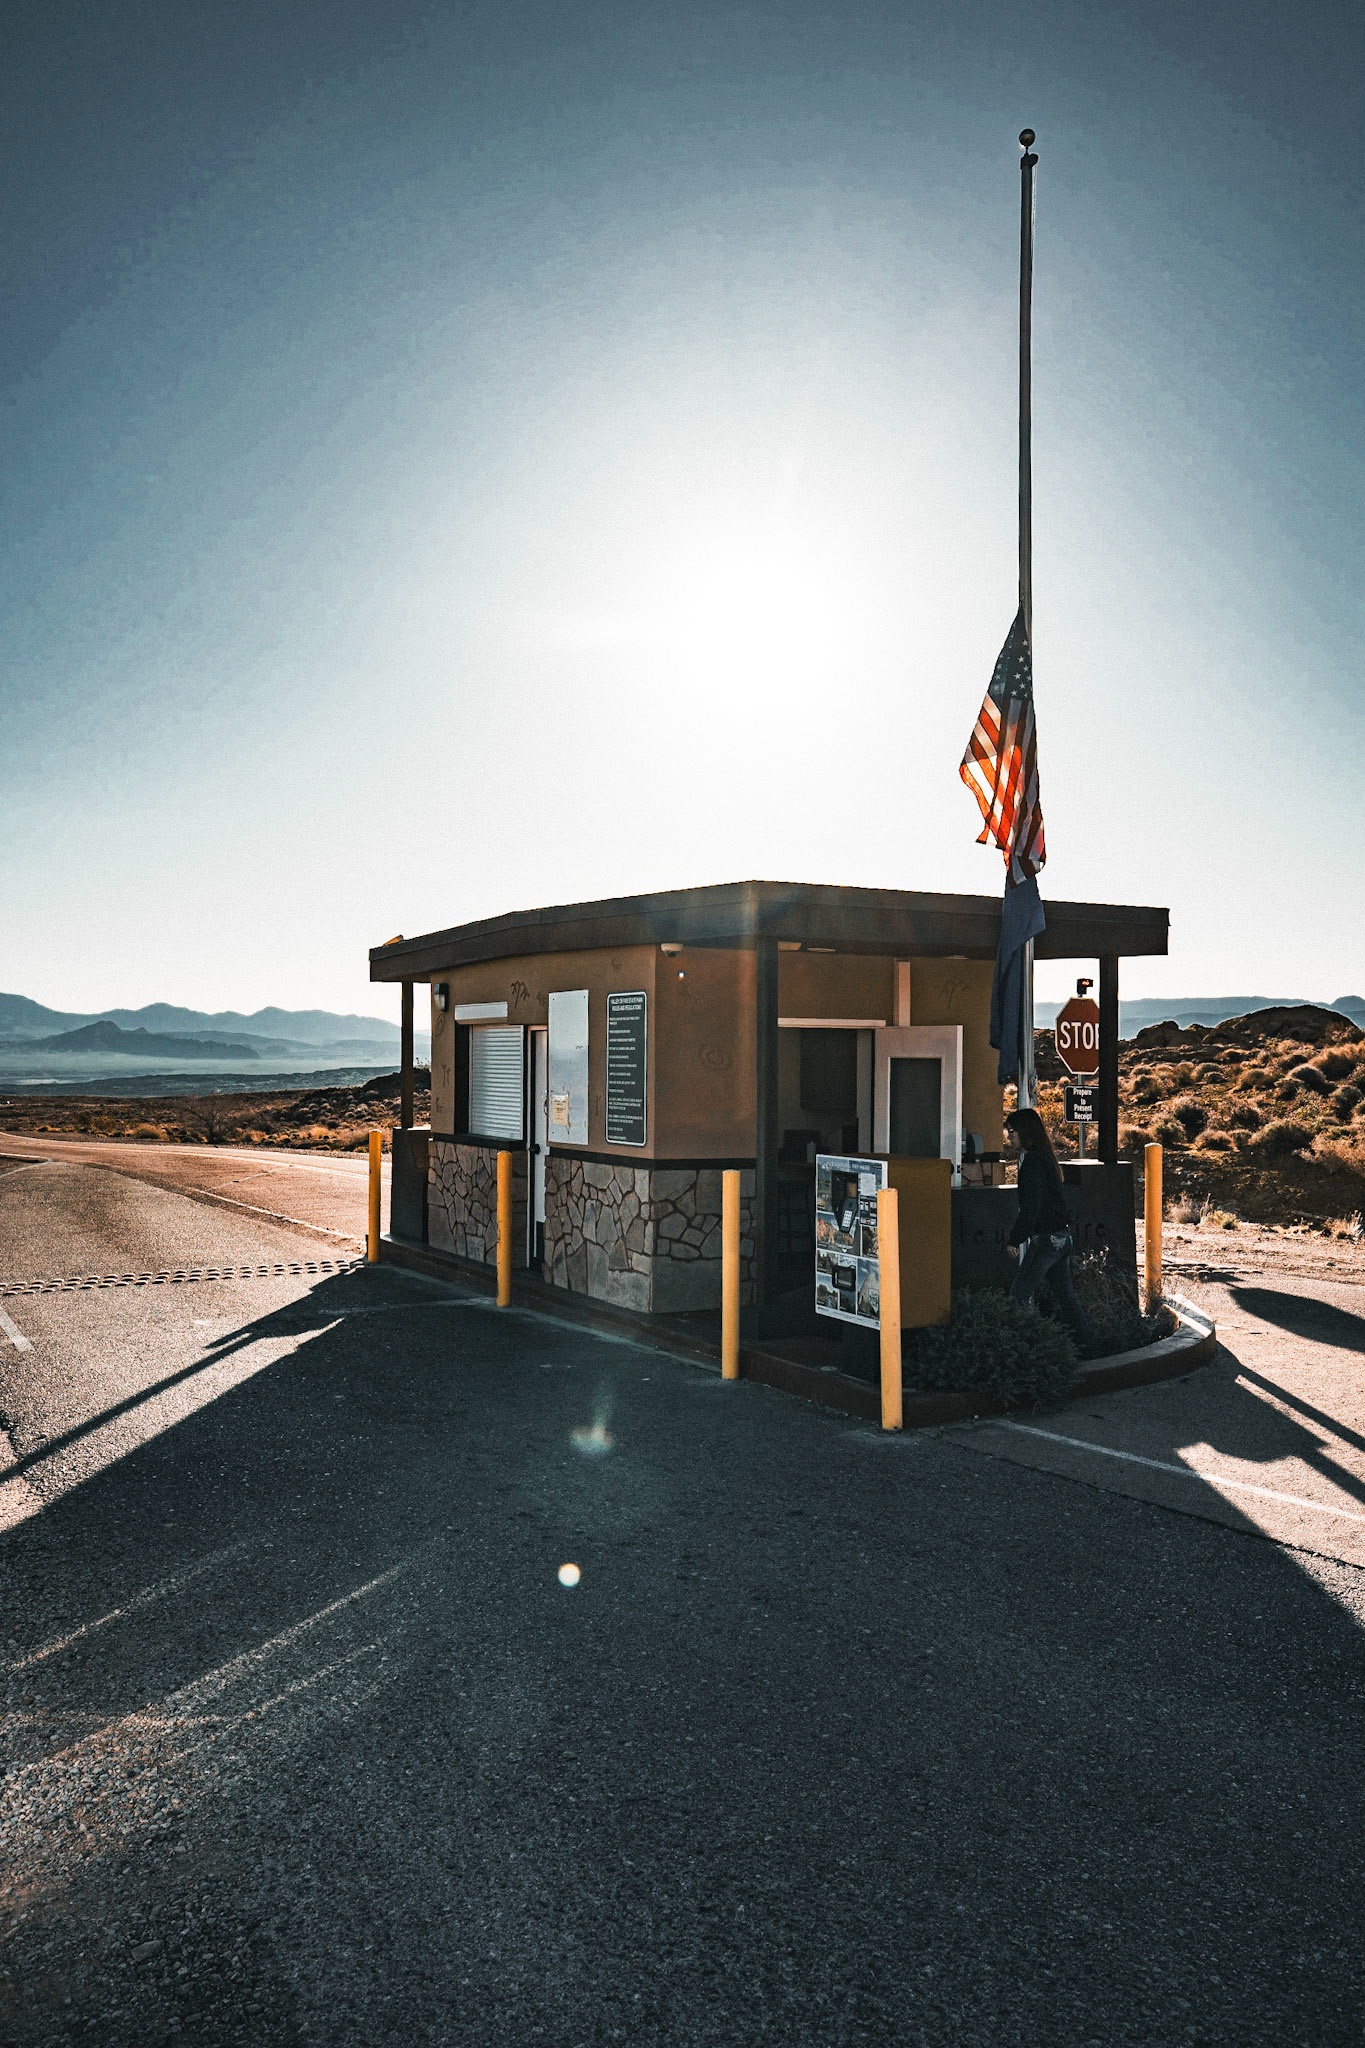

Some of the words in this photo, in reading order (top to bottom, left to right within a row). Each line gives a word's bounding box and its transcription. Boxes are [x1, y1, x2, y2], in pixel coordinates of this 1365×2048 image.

[1073, 1088, 1092, 1097] Prepare
[1073, 1104, 1092, 1112] Present
[1074, 1112, 1092, 1121] Receipt
